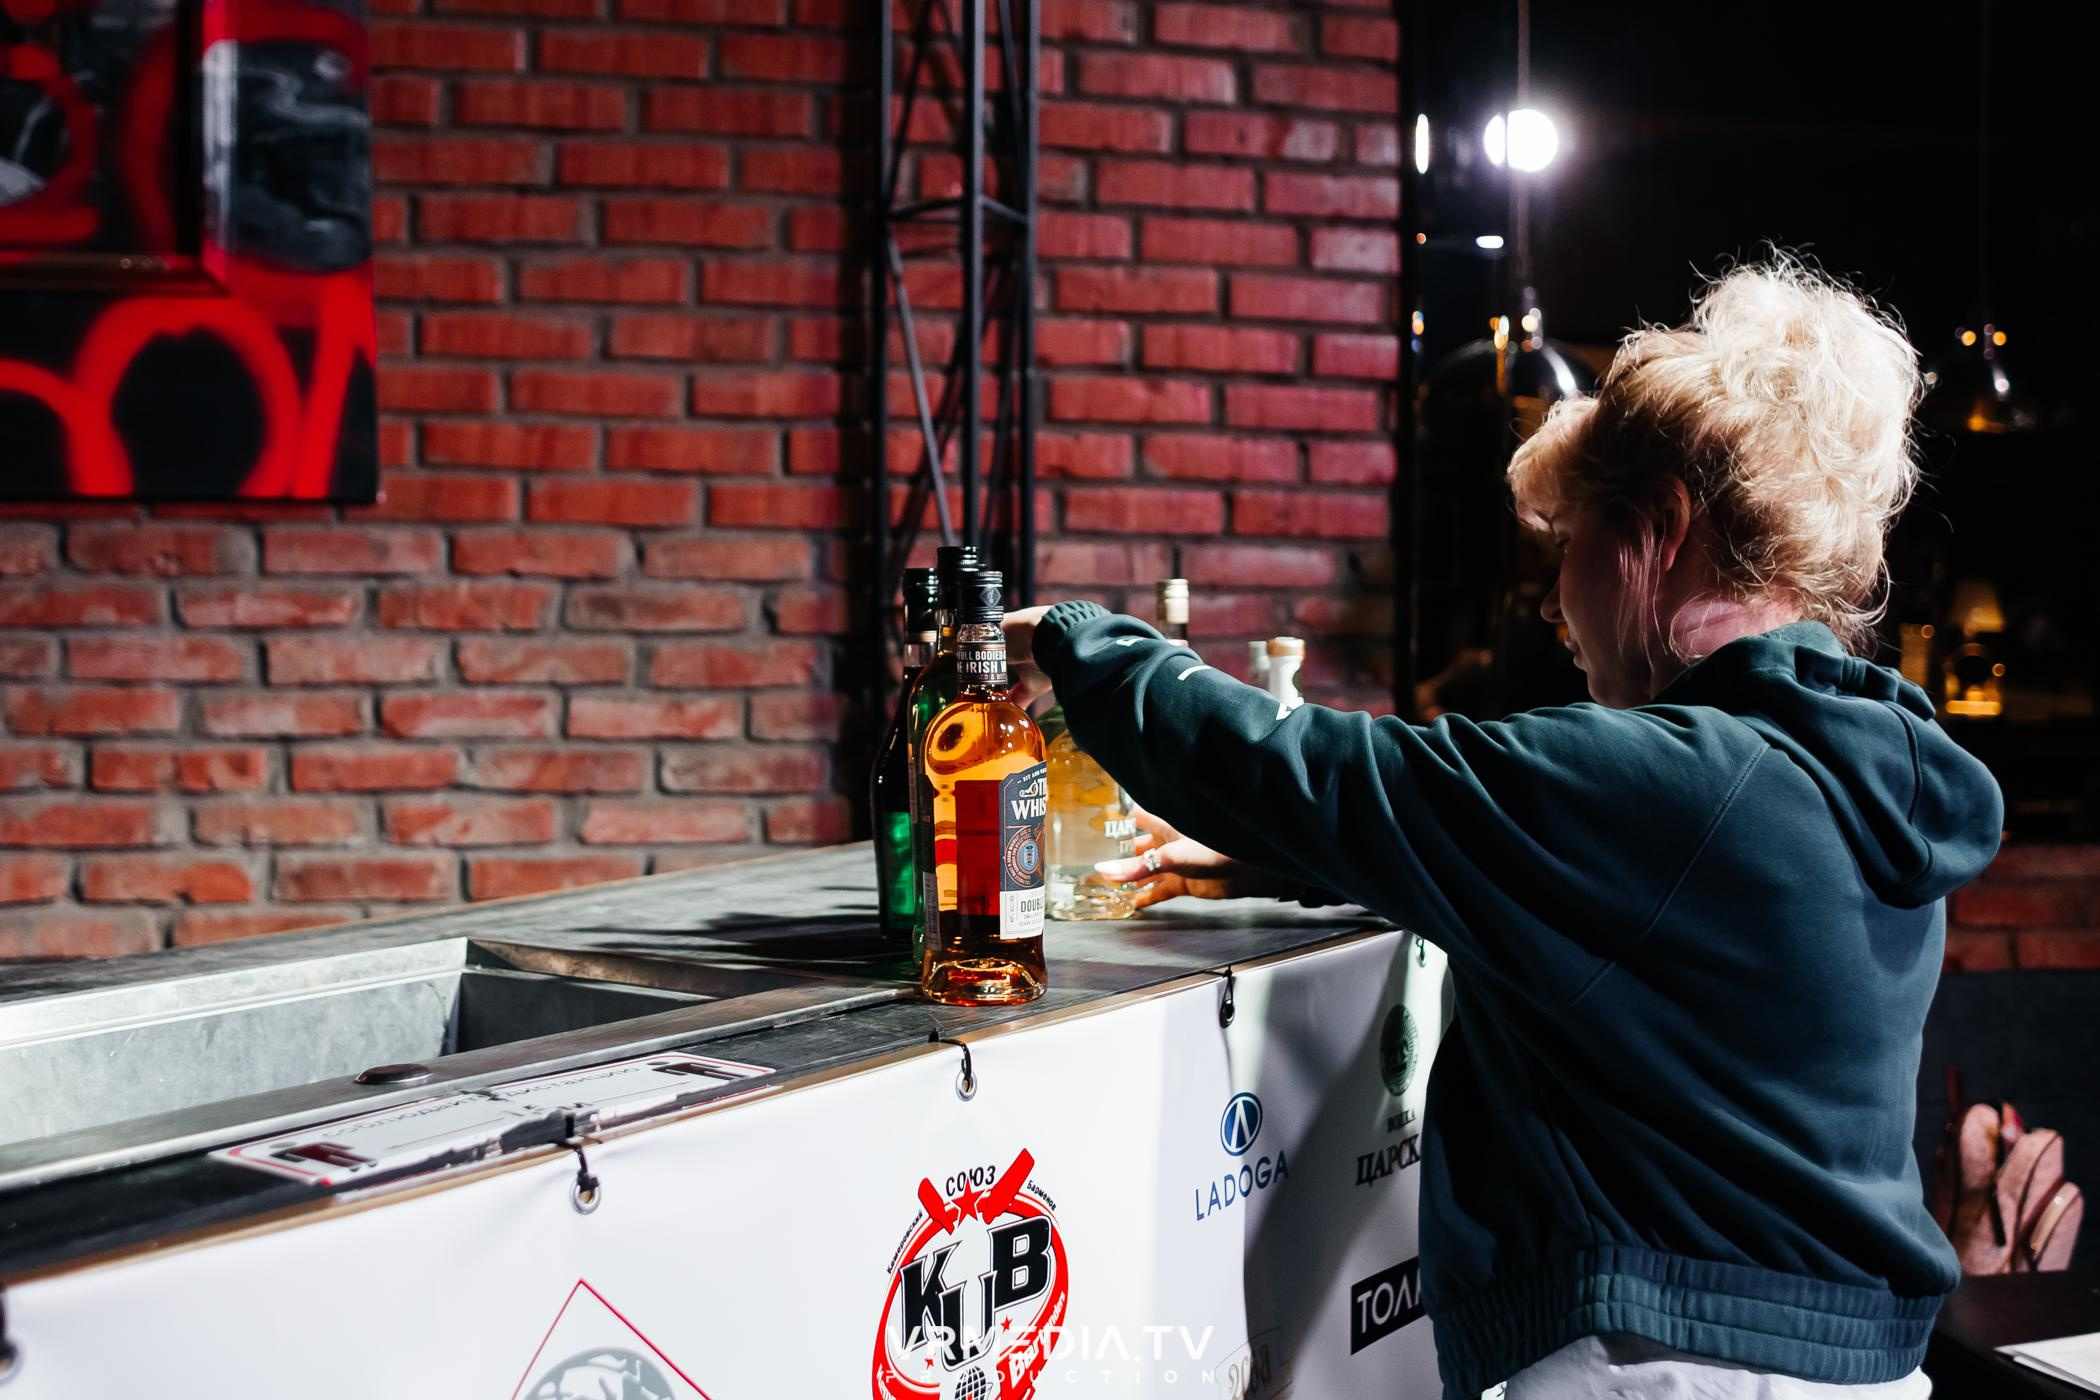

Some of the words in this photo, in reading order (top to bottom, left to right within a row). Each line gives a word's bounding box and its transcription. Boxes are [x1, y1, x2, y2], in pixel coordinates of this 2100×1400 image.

[966, 661, 998, 674] IRISH
[945, 1165, 997, 1197] СОЮЗ
[1195, 1149, 1289, 1222] LADOGA
